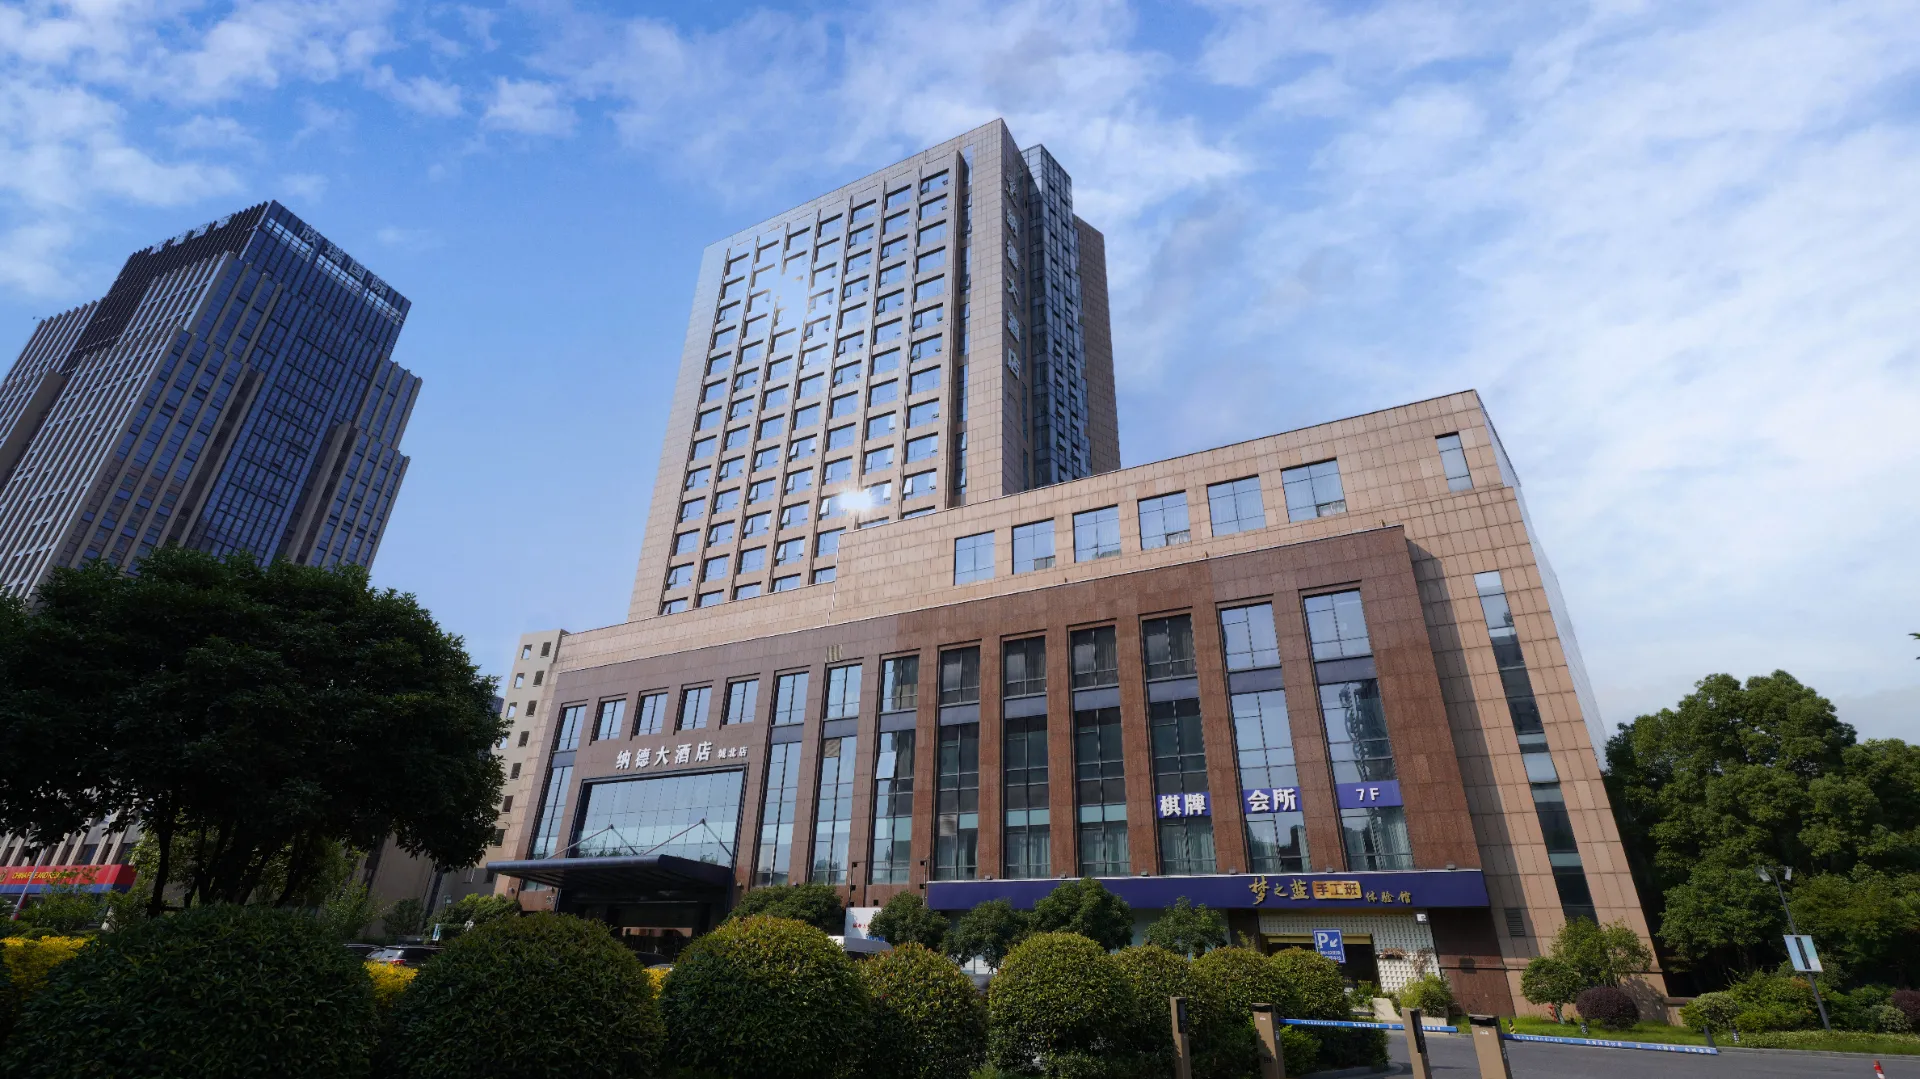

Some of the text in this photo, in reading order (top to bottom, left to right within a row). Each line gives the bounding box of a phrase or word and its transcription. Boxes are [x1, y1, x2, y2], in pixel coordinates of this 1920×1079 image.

[300, 224, 389, 296] 欣瑞国际
[615, 741, 712, 769] 纳德大酒店
[1160, 787, 1380, 817] 棋牌 会所 7F
[1249, 875, 1413, 905] 梦之蓝 手工班 体验馆
[1317, 932, 1329, 949] P
